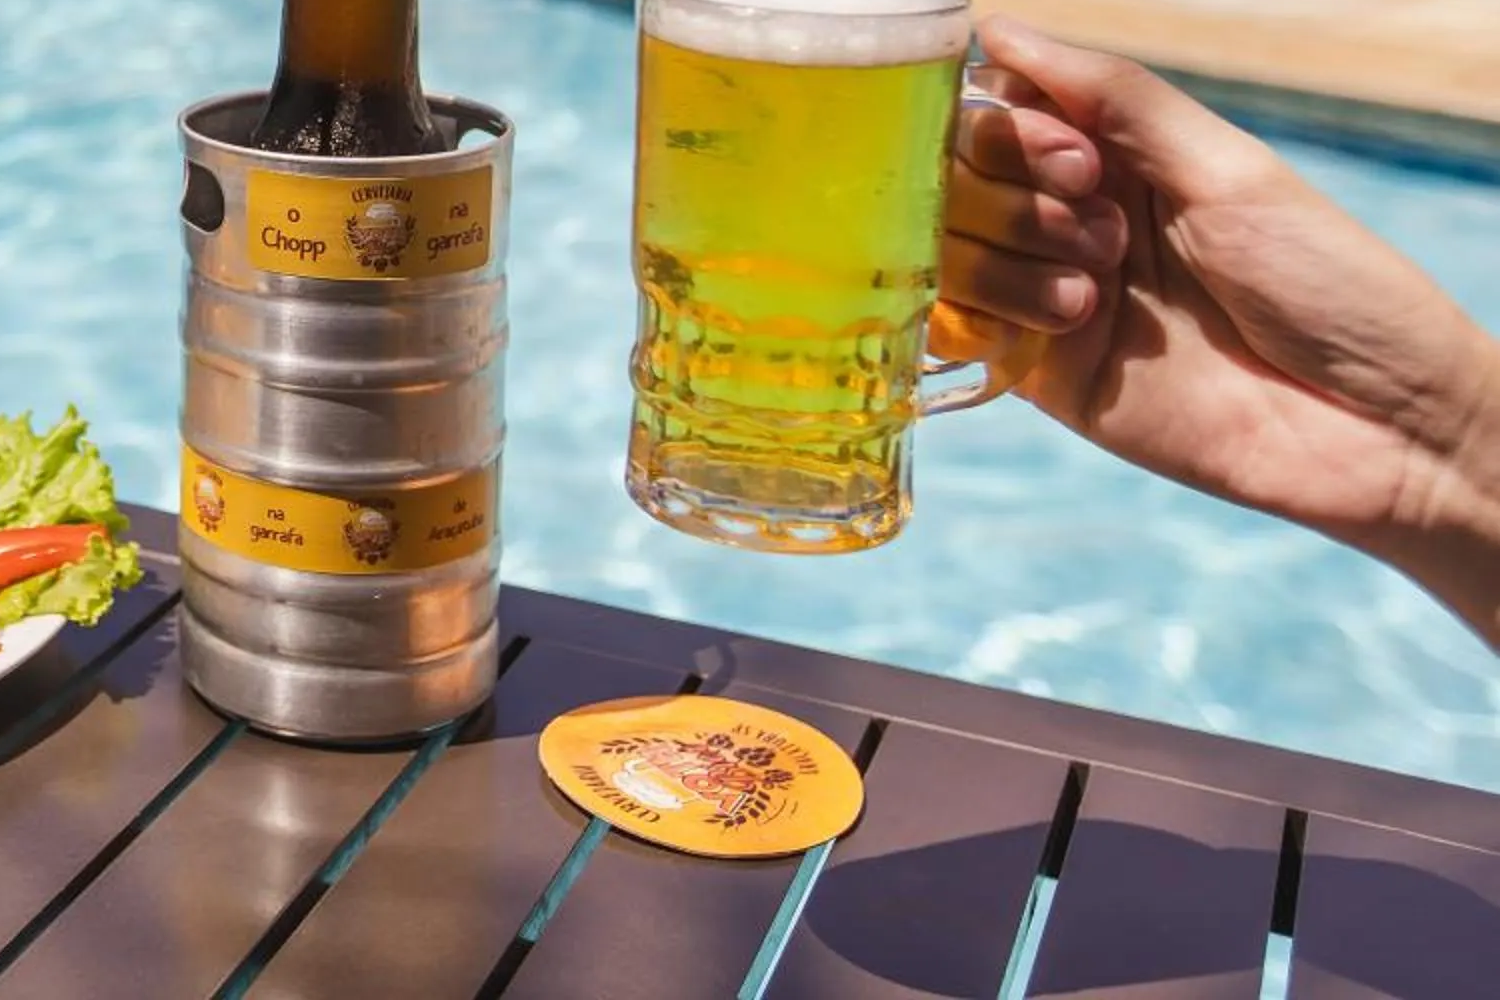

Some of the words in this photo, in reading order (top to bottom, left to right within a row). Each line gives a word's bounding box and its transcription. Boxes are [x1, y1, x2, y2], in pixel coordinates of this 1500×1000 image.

[449, 202, 468, 220] na
[261, 226, 326, 262] Chopp
[426, 224, 483, 259] garrafa
[267, 508, 285, 521] na
[250, 524, 304, 547] garrafa
